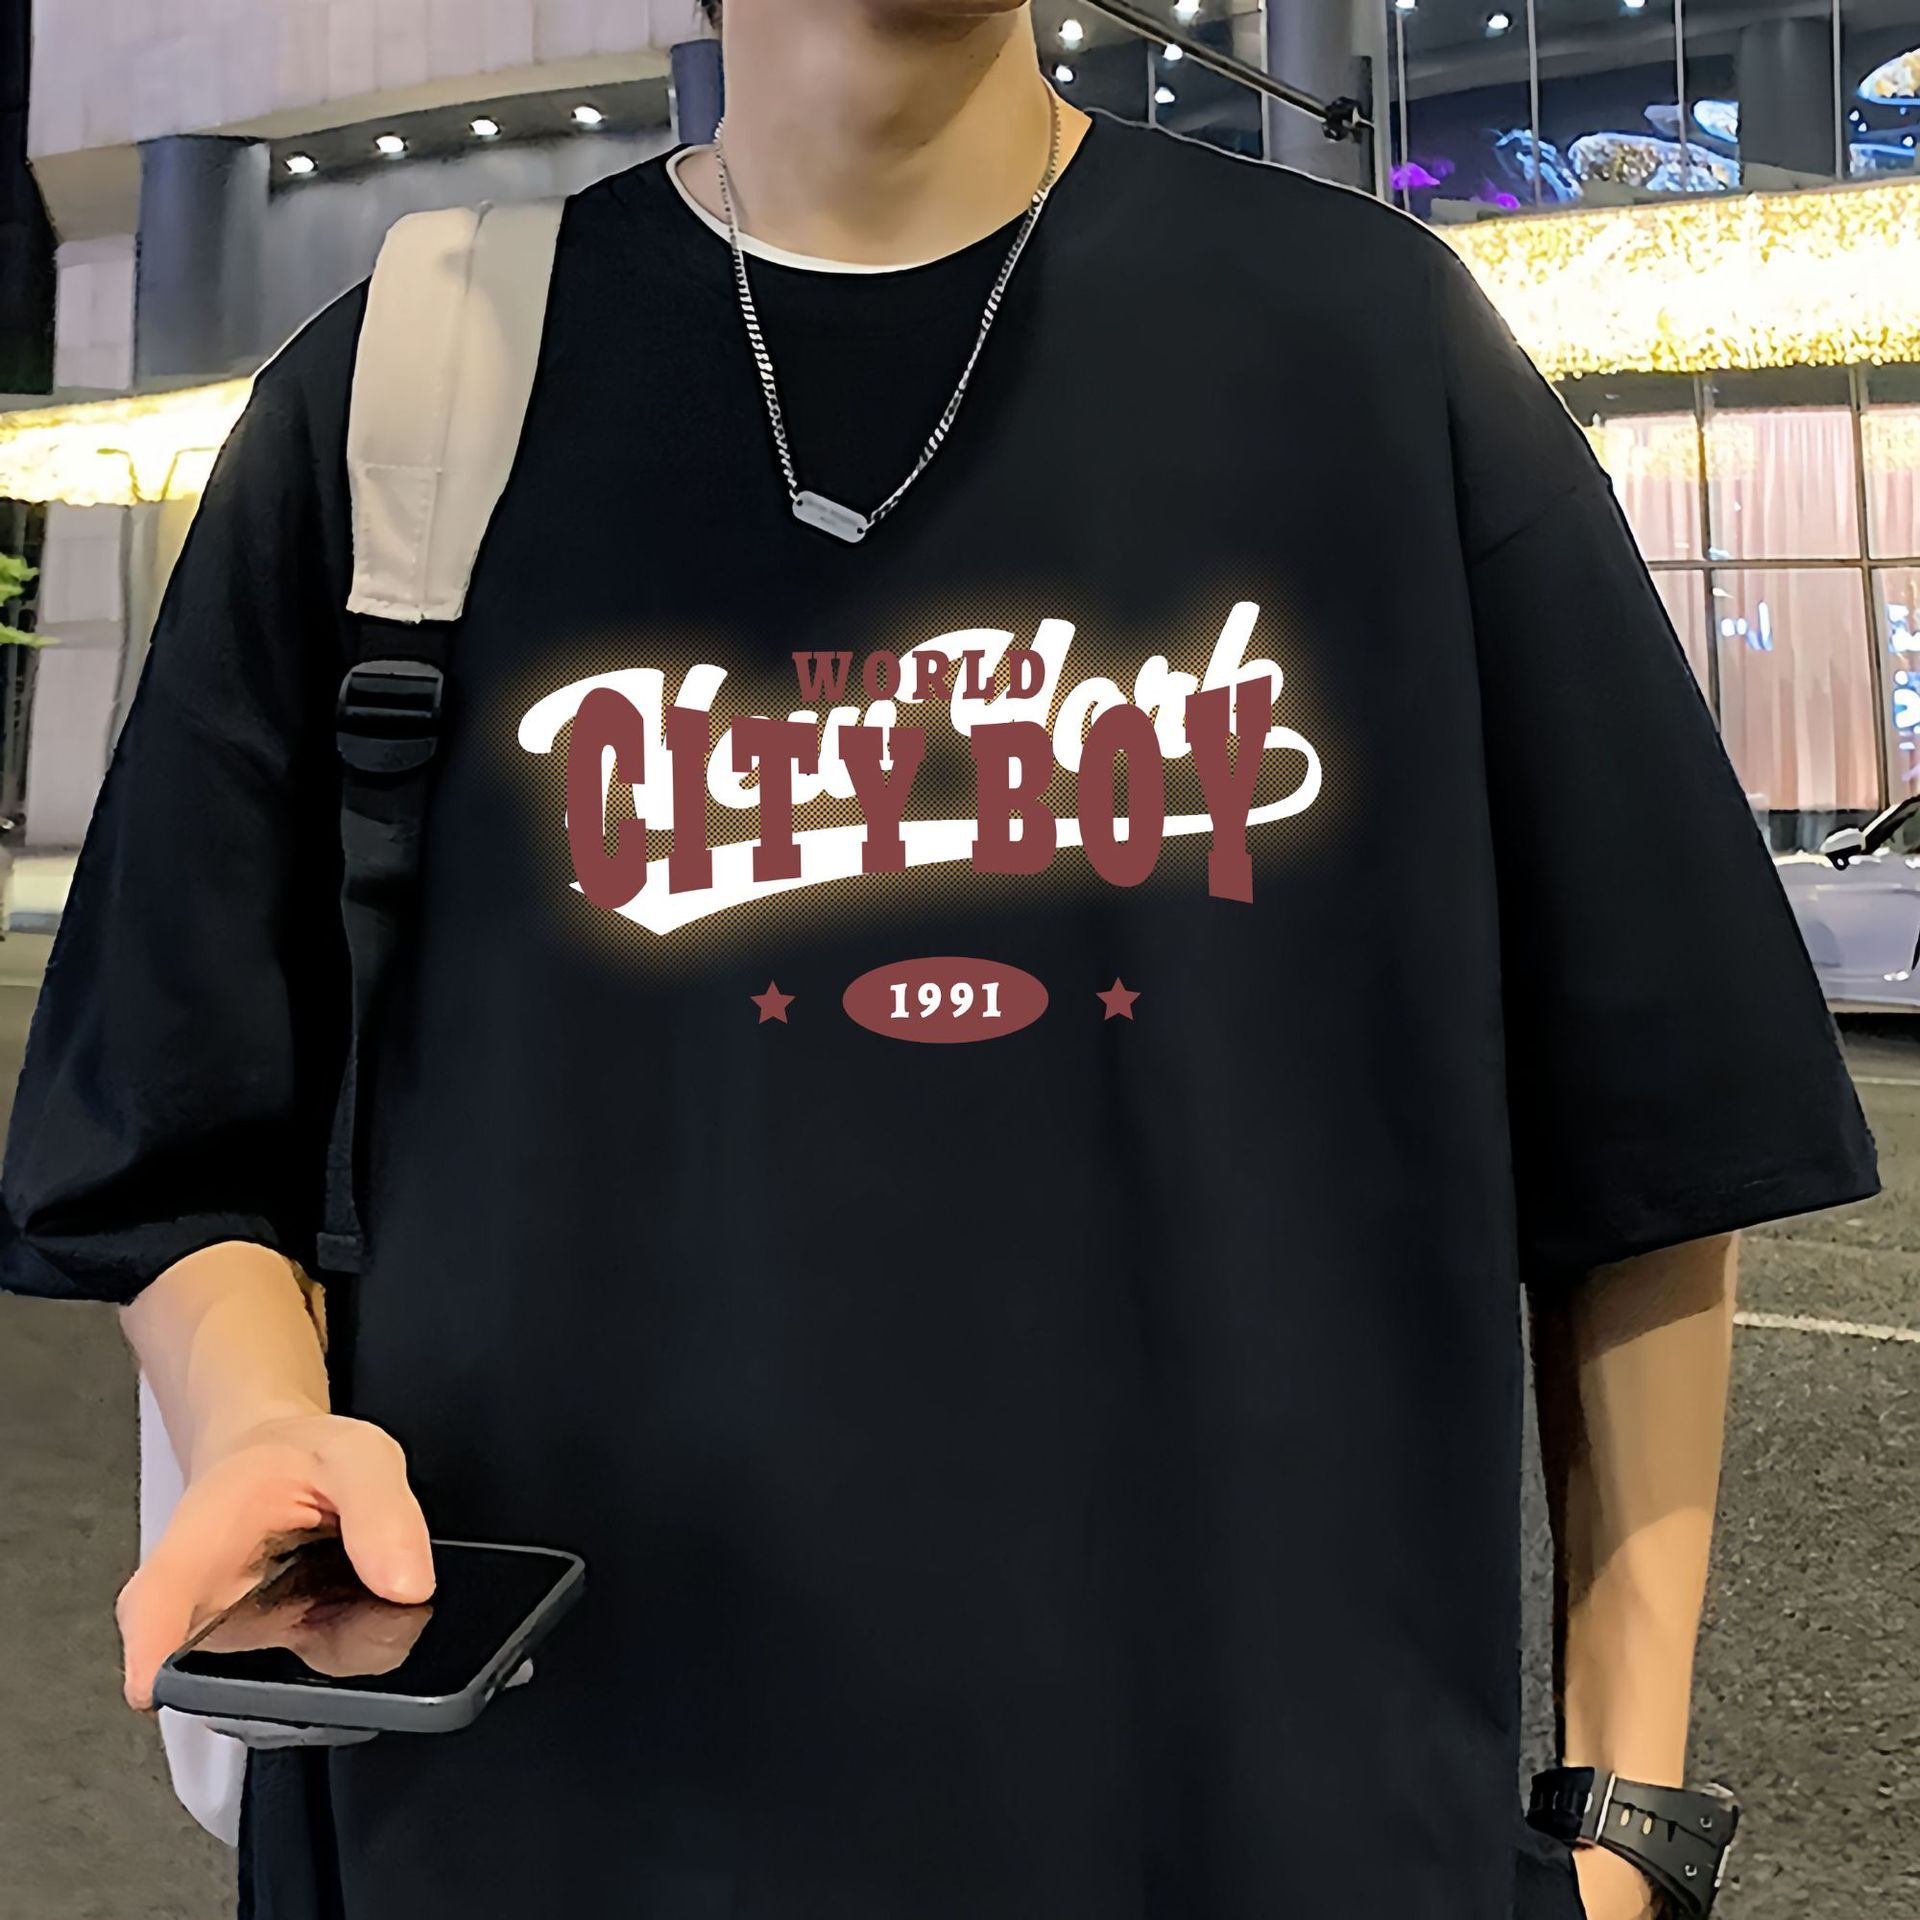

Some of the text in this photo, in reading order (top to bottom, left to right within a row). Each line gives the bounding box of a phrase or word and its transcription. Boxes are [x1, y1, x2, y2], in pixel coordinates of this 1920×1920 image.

[791, 646, 1046, 705] WORLD
[560, 675, 1275, 913] CITY BOY
[889, 982, 1002, 1019] 1991
